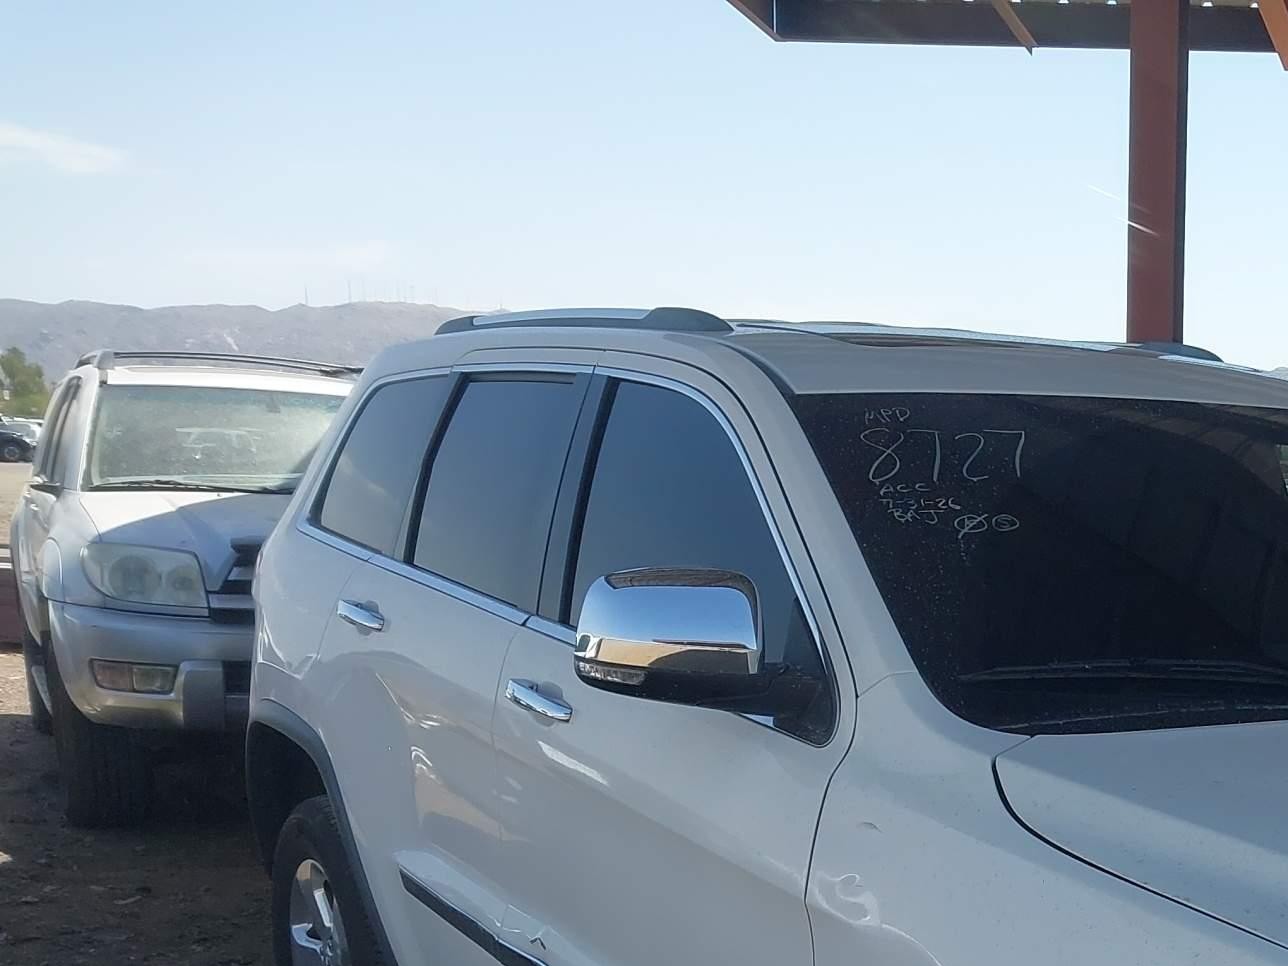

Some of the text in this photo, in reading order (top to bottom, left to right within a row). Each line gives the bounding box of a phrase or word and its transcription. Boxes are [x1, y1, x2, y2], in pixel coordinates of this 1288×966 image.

[864, 407, 911, 425] MPD
[860, 427, 1026, 486] 8727
[879, 482, 932, 497] ACC
